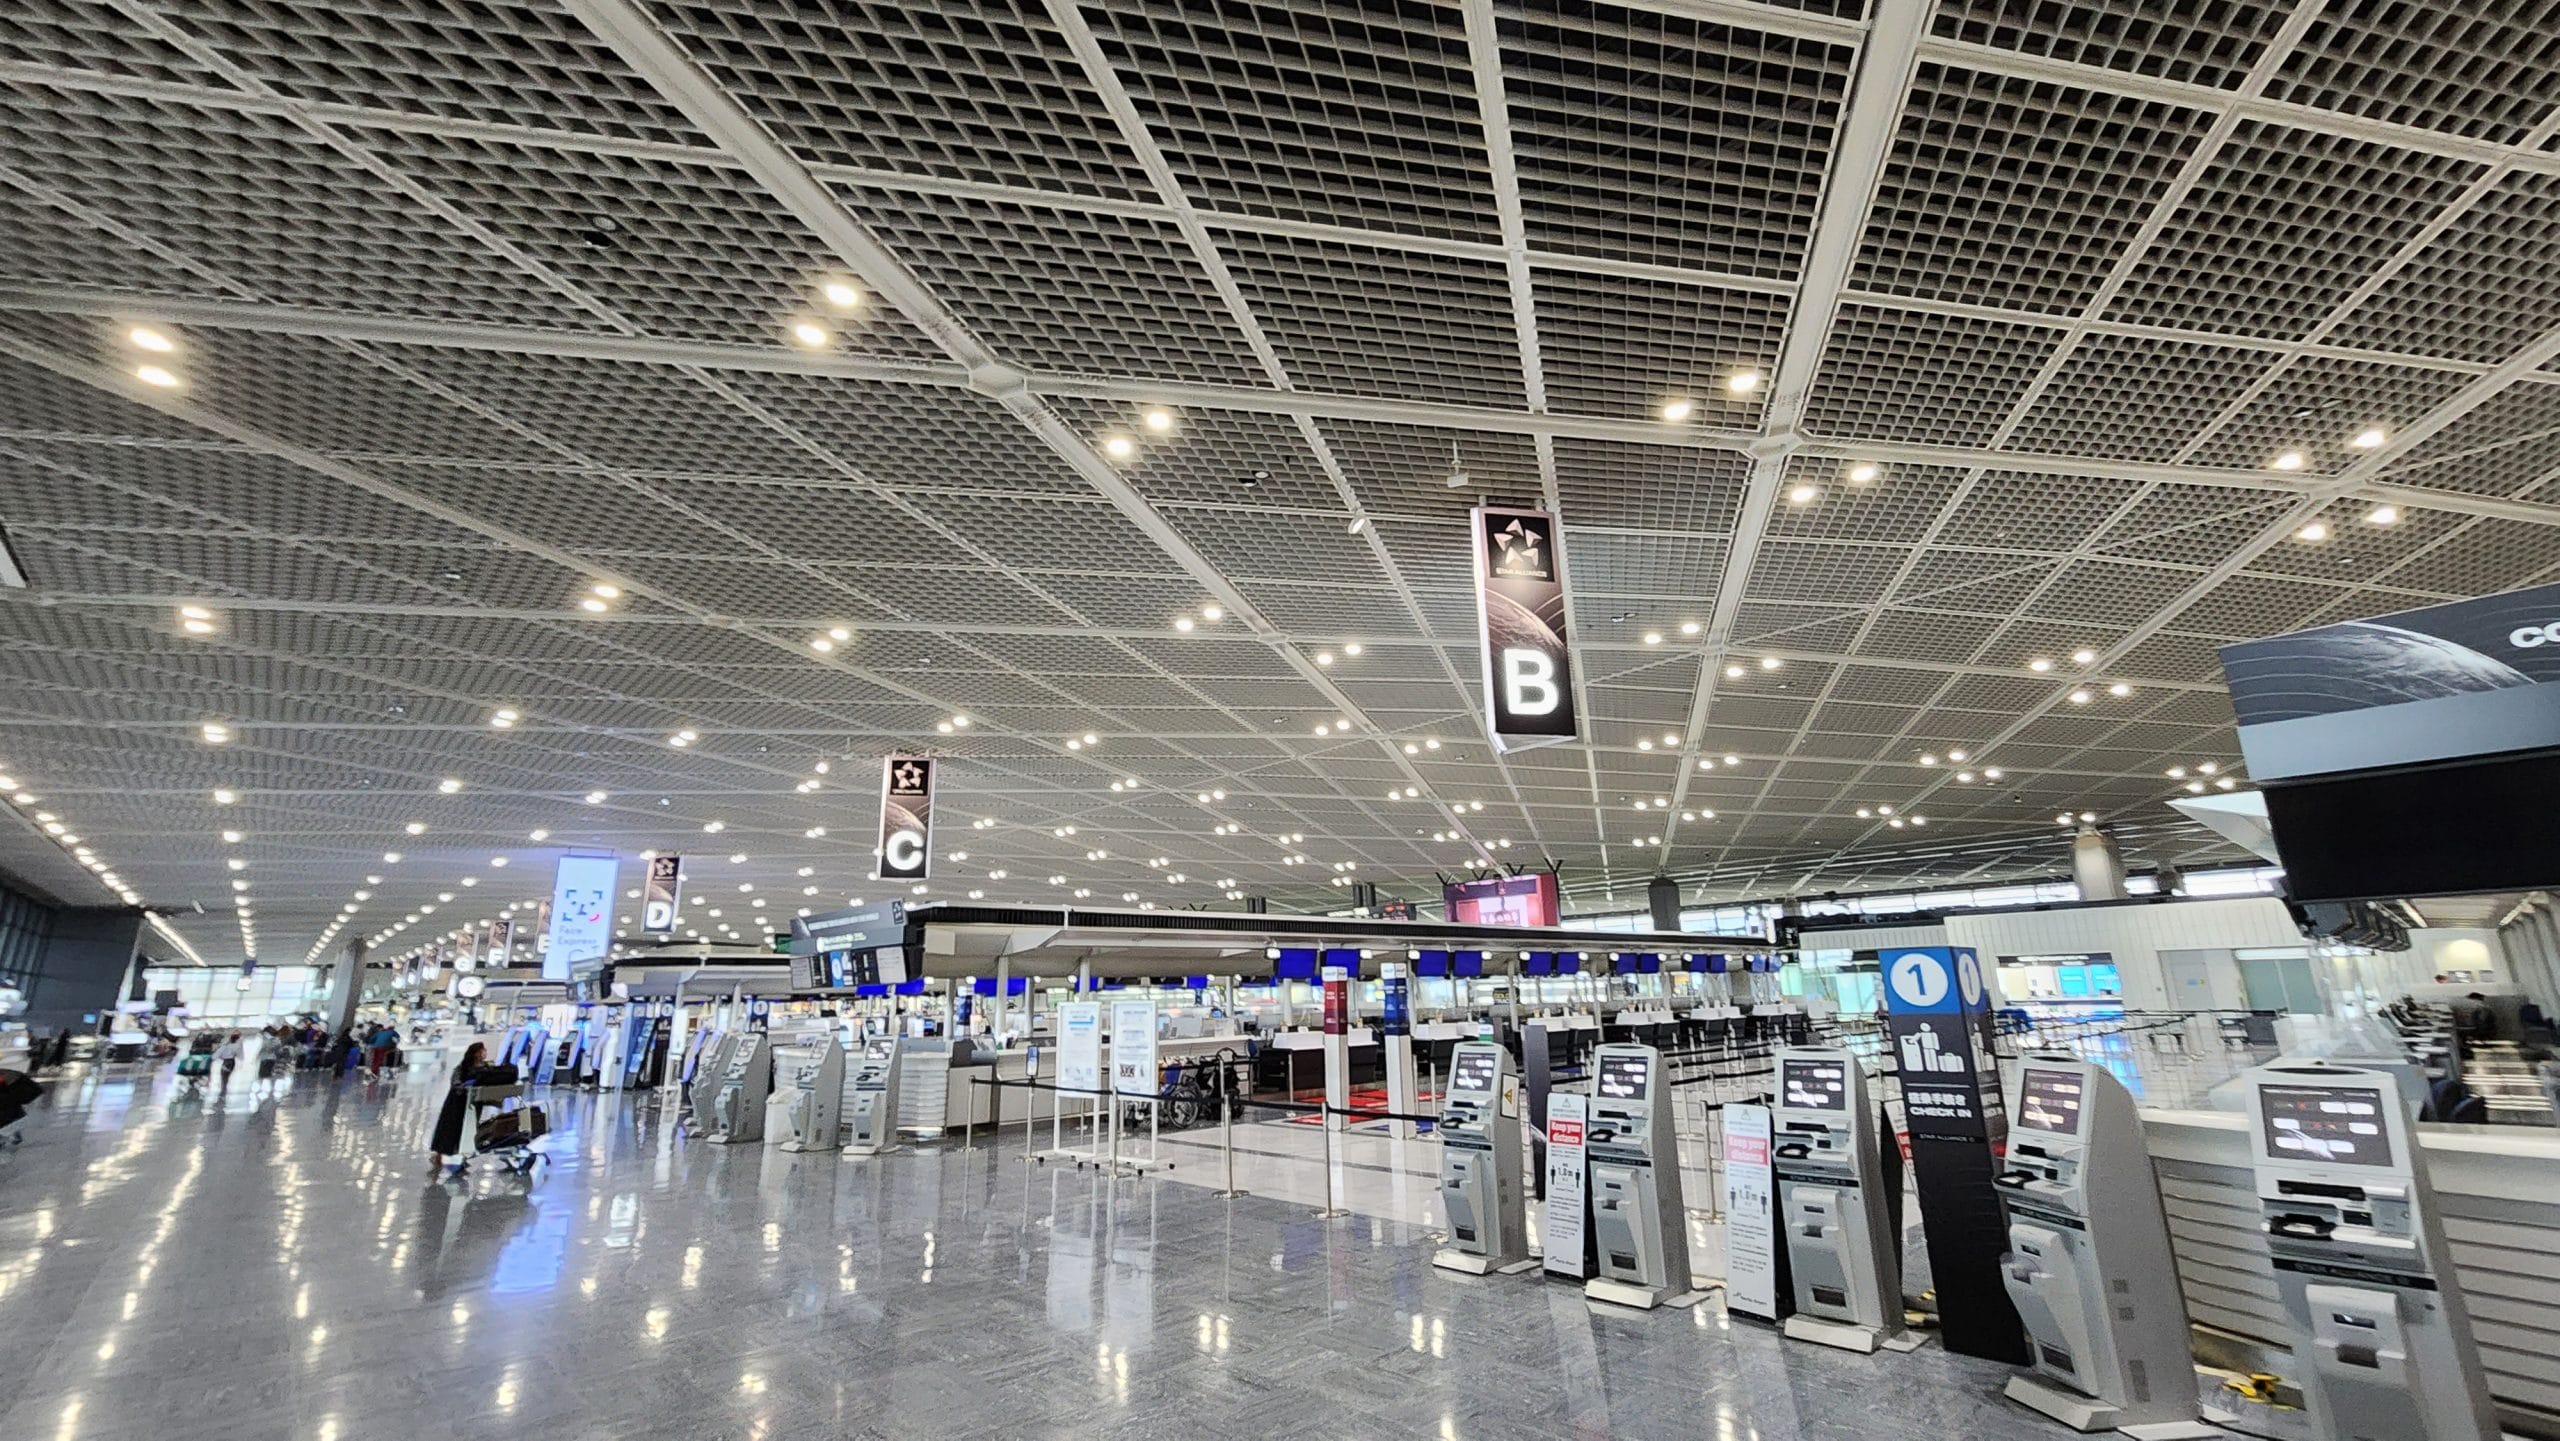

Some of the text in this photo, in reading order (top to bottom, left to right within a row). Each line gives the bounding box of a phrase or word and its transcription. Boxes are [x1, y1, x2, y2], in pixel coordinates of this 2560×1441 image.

[1503, 648, 1559, 716] B
[887, 830, 925, 870] C
[646, 901, 673, 928] D
[488, 948, 504, 966] F
[1907, 963, 1926, 996] 1
[1964, 961, 1973, 996] 1
[1909, 1106, 1972, 1118] CHECK IN
[1728, 1135, 1766, 1151] Keep your
